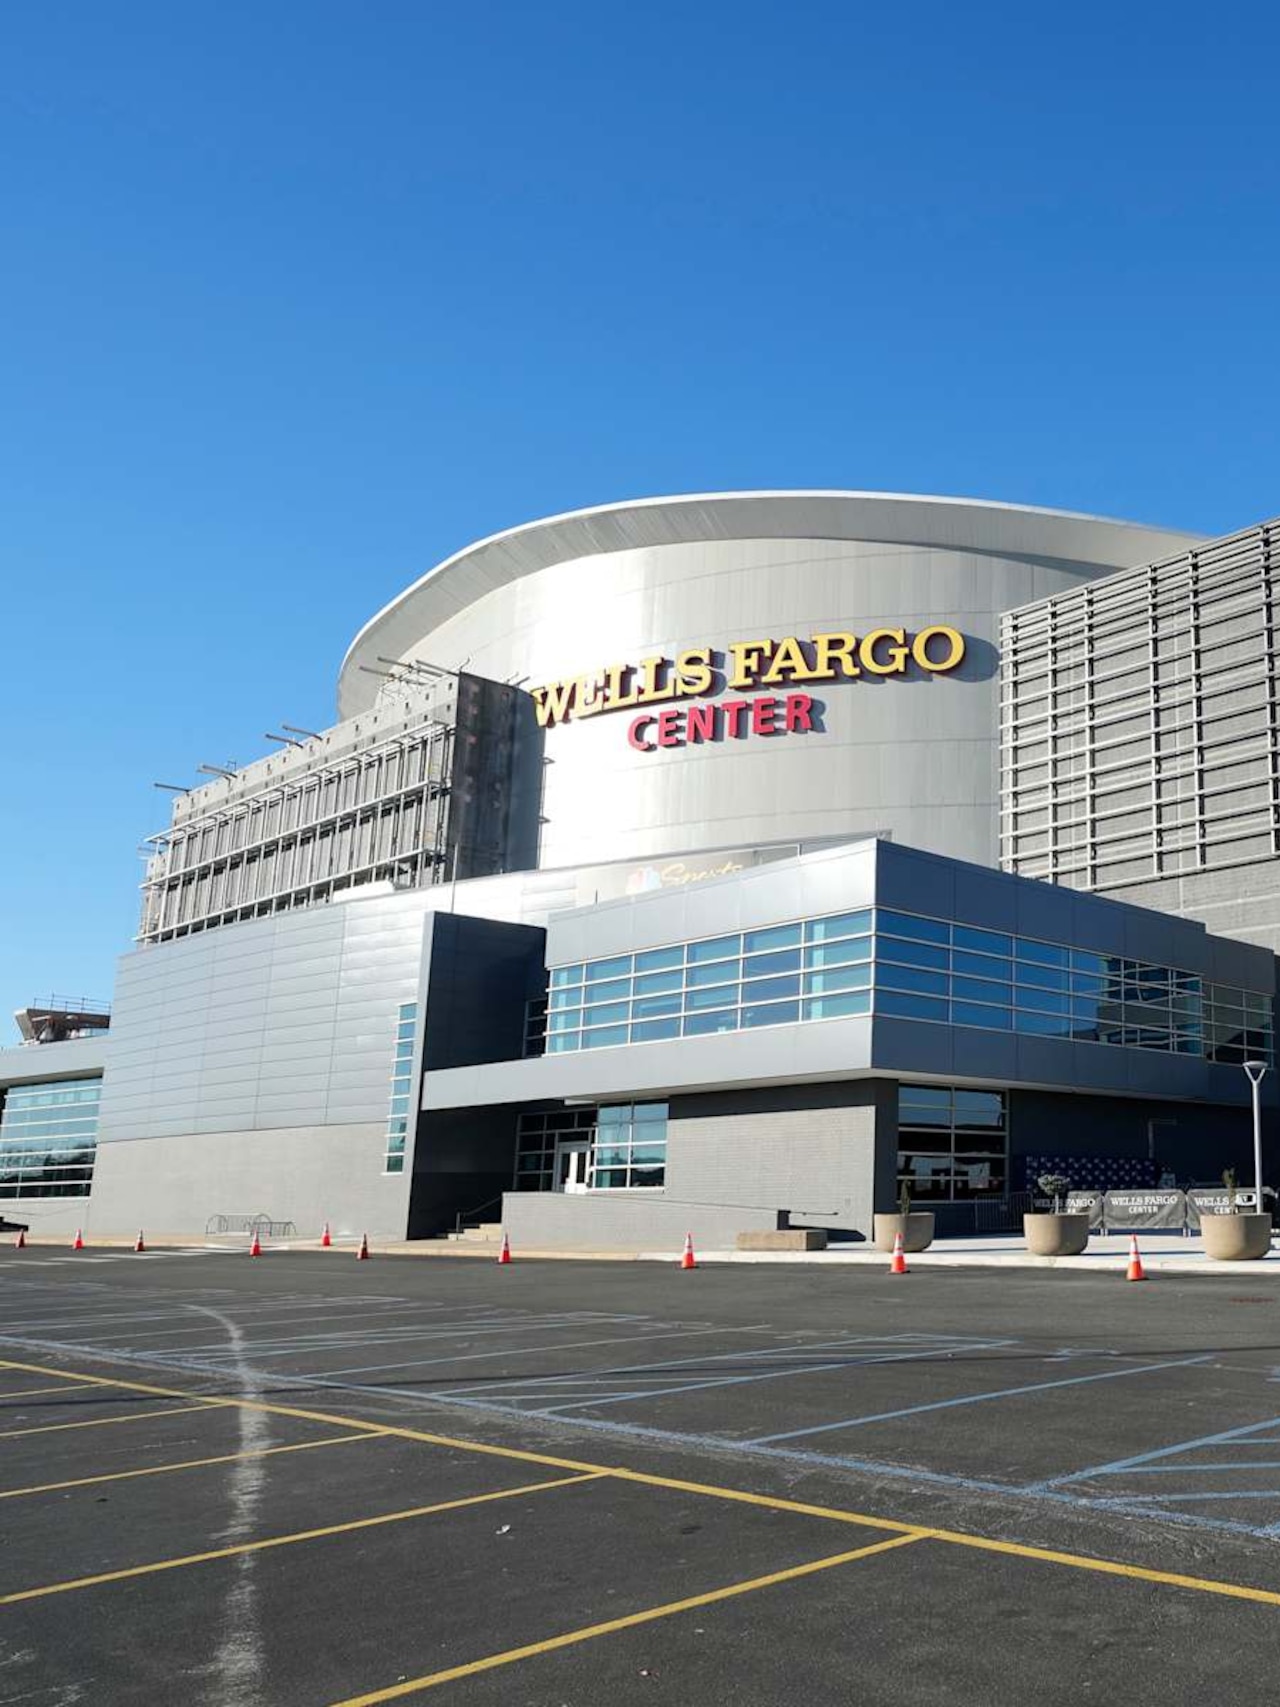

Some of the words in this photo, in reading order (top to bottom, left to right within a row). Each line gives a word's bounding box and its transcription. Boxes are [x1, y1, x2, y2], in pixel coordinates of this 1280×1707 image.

[532, 649, 712, 727] WELLS
[728, 625, 966, 688] FARGO
[626, 694, 813, 751] CENTER
[1110, 1196, 1143, 1206] WELLS
[1144, 1195, 1178, 1205] FARGO
[1194, 1197, 1229, 1206] WELLS
[1128, 1205, 1159, 1214] CENTER
